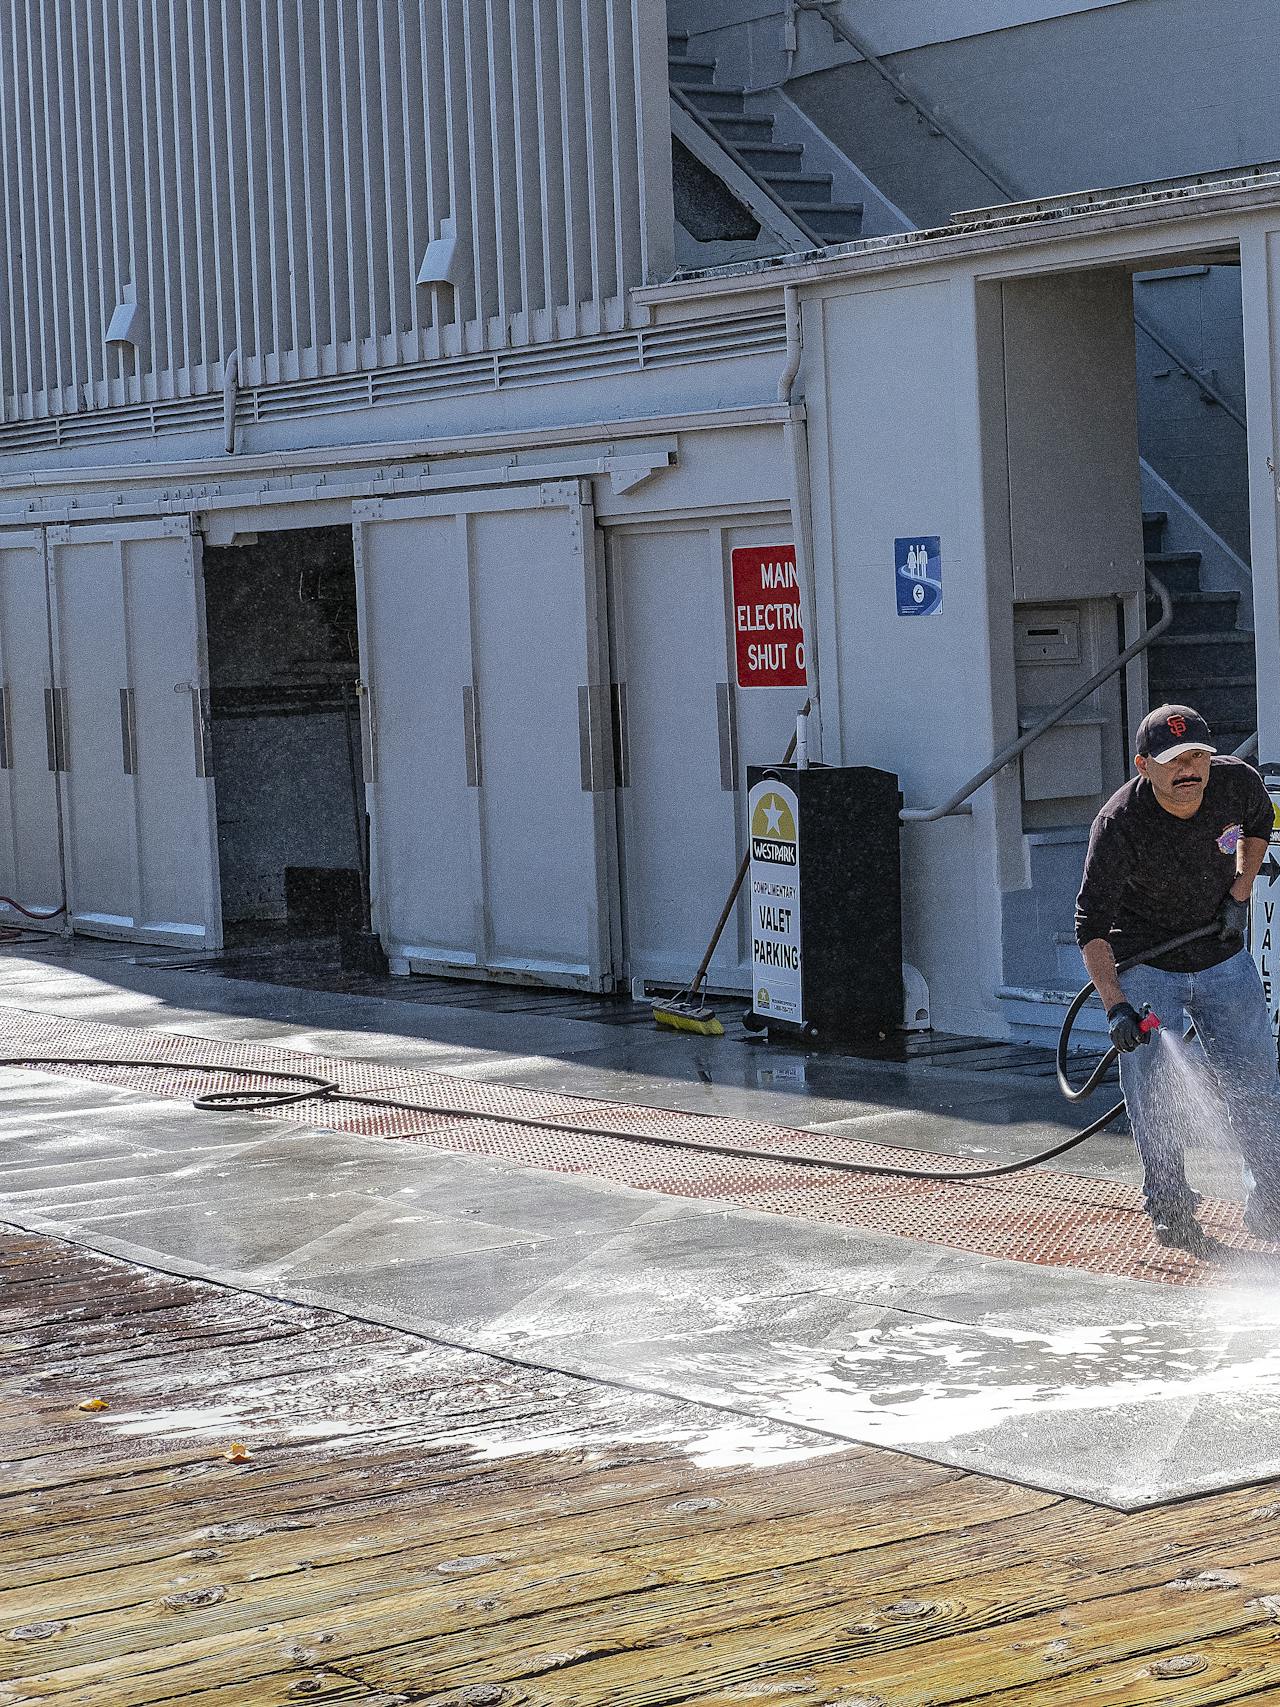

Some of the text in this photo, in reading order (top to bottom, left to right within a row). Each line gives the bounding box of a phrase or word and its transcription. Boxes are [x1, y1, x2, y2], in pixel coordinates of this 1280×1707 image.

[761, 561, 800, 589] MAIN
[747, 643, 788, 671] SHUT
[753, 841, 795, 863] WESTPARK
[759, 905, 791, 934] VALET
[754, 939, 799, 970] PARKING
[1262, 901, 1275, 1014] VALE
